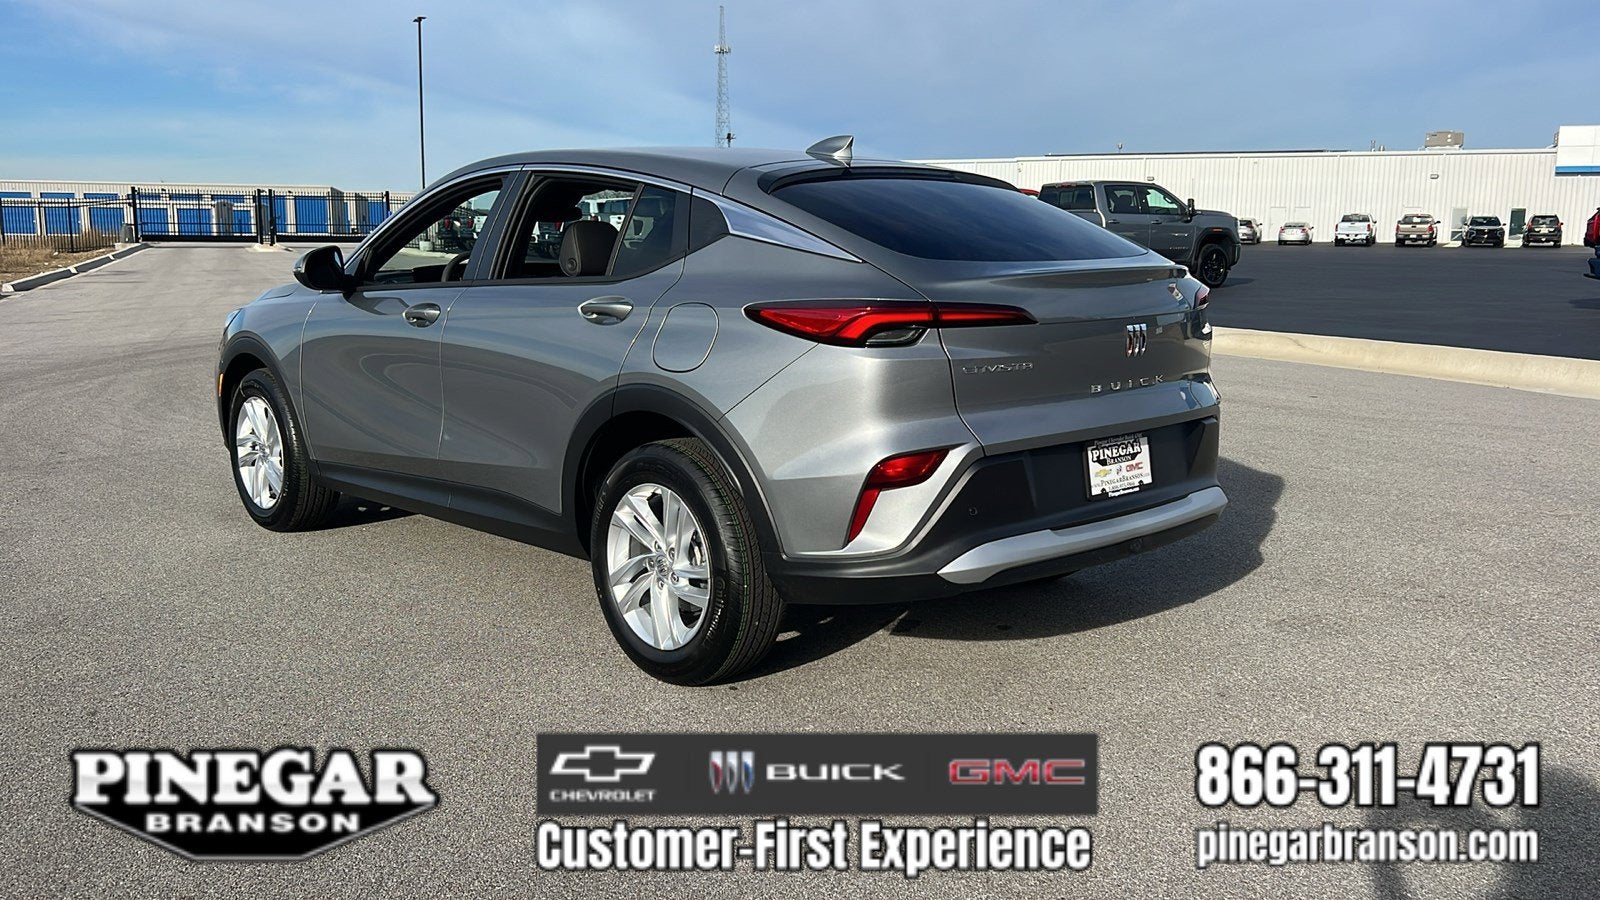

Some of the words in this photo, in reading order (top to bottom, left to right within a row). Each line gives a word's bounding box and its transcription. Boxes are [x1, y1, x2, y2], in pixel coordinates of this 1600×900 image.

[1090, 374, 1164, 394] BUICK
[1092, 442, 1142, 461] PINEGAR
[1126, 461, 1144, 472] GMC
